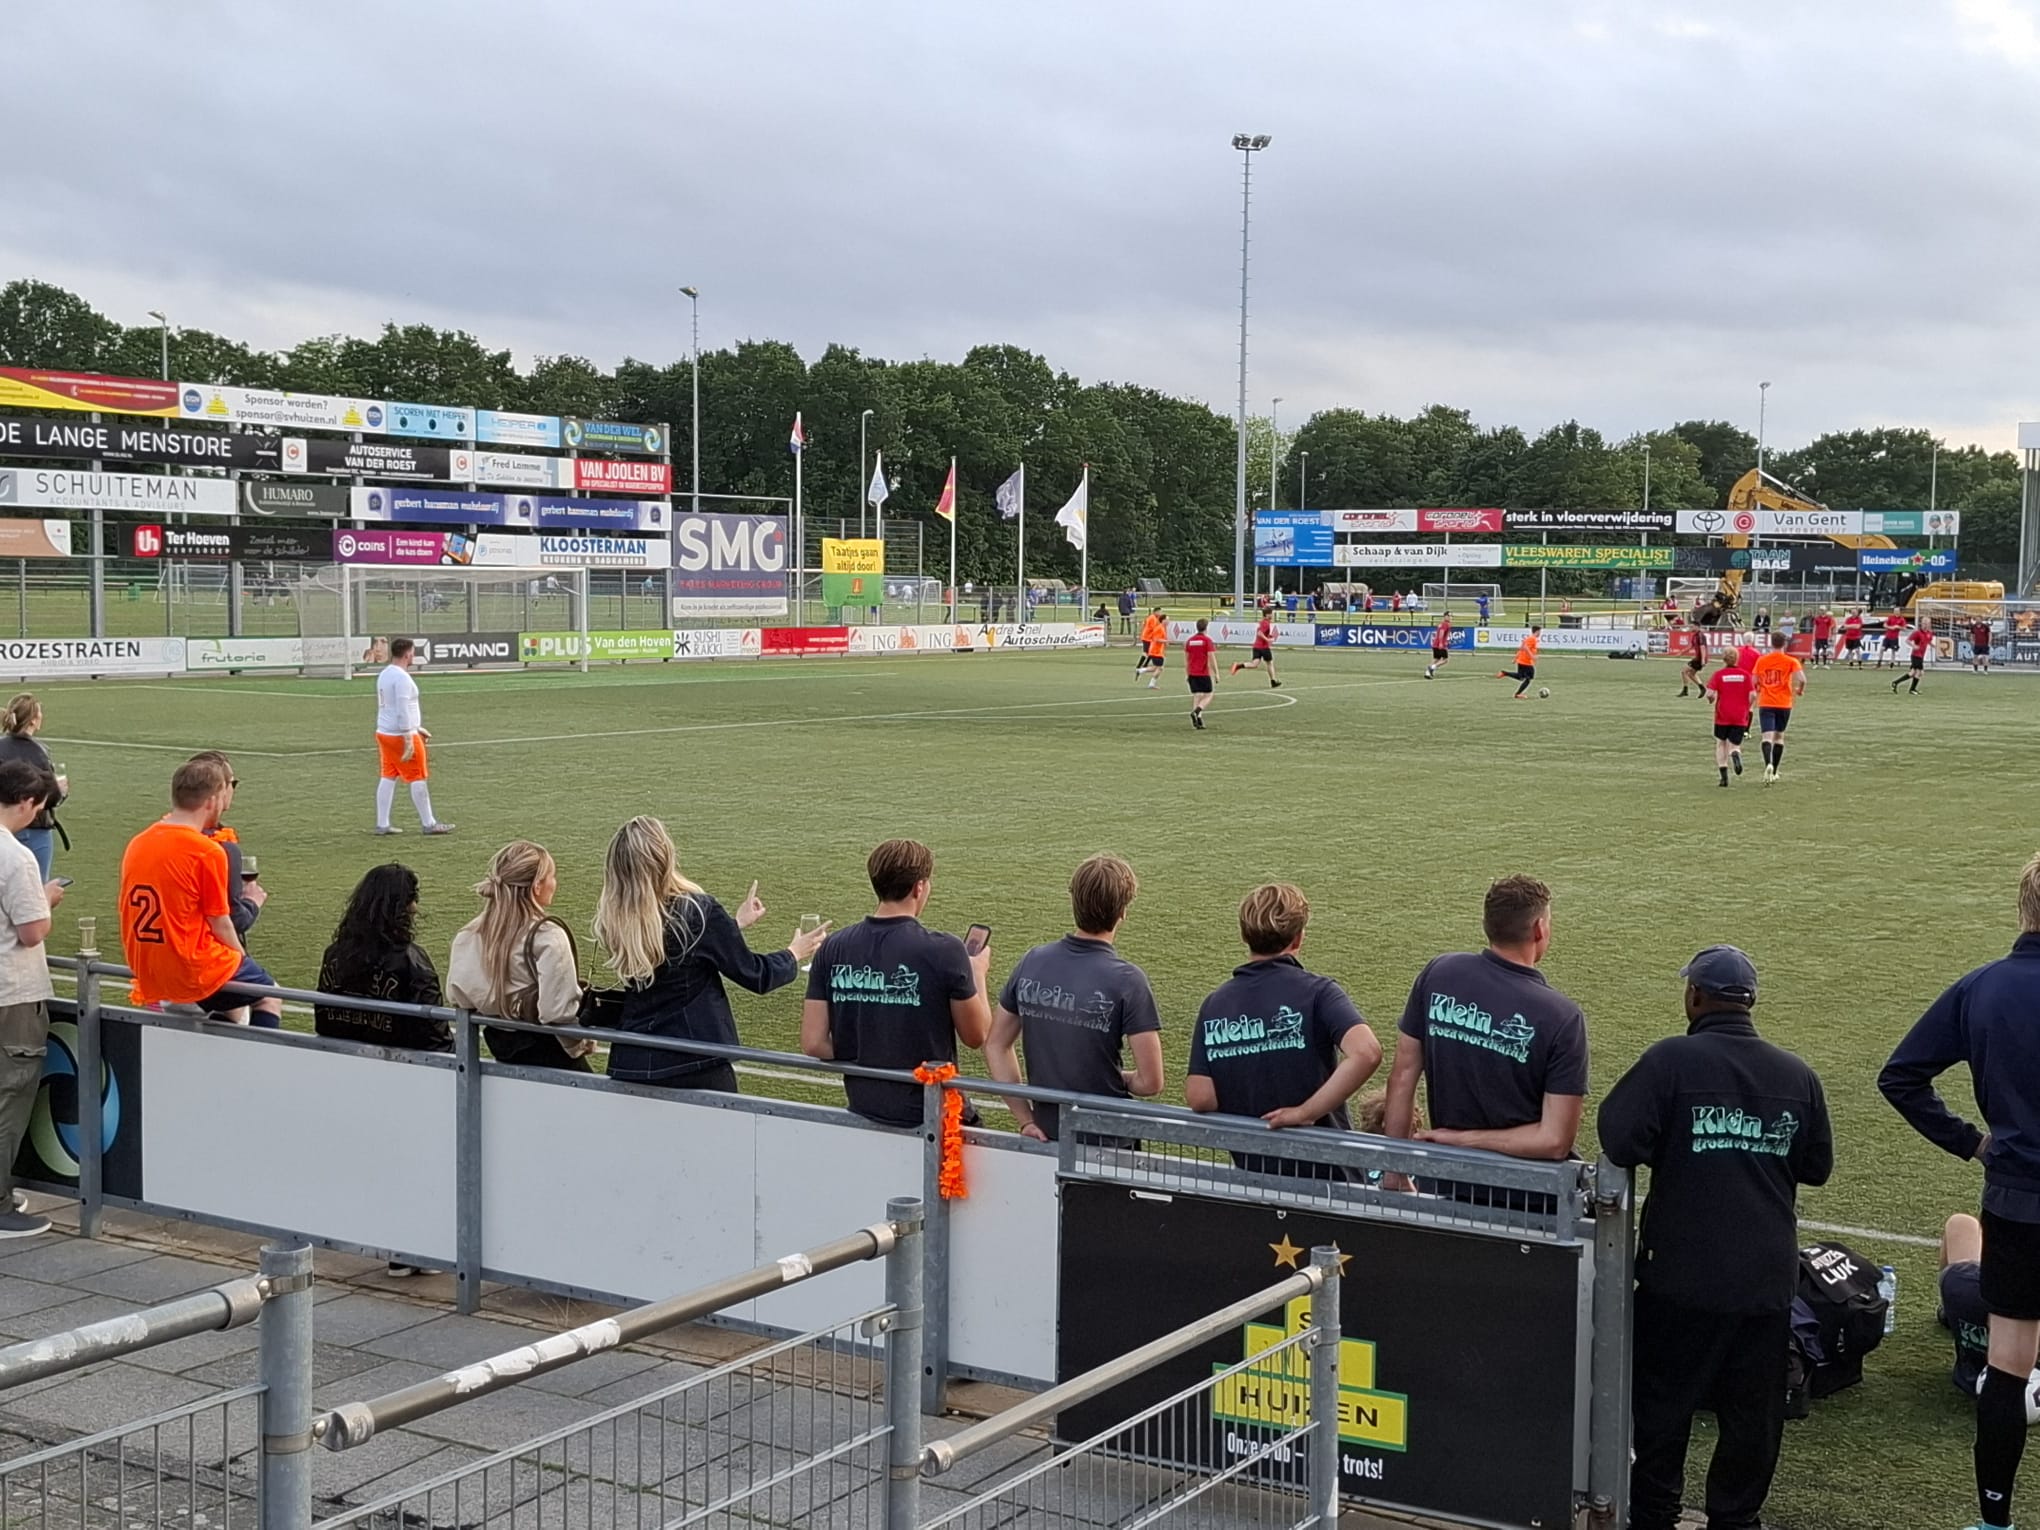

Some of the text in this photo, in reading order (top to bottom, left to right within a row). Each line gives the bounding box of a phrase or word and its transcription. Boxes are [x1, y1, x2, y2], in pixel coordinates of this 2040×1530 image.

[244, 394, 328, 410] Sponsor worden?
[236, 409, 337, 426] sponsor@svhuizen.nl
[394, 407, 424, 417] SCOREN
[36, 424, 109, 449] LANGE
[121, 430, 232, 458] MENSTORE
[349, 445, 412, 458] AUTOSERVICE
[345, 456, 416, 471] VAN DER ROEST
[492, 458, 510, 469] Fred
[580, 461, 665, 482] VAN JOOLEN BV
[36, 472, 197, 500] SCHUITEMAN
[263, 488, 314, 501] HUMARO
[1292, 517, 1320, 525] ROEST
[1506, 510, 1673, 526] sterk in vloerverwijdering
[1774, 513, 1847, 525] Van Gent
[166, 530, 230, 546] Ter Hoeven
[408, 538, 423, 547] kind
[423, 539, 435, 547] kan
[540, 537, 647, 554] KLOOSTERMAN
[679, 517, 784, 572] SMG
[358, 540, 385, 552] coins
[1353, 547, 1447, 557] Schaap & van Dijk
[1506, 547, 1591, 557] VLEESWAREN
[1595, 548, 1672, 559] SPECIALIST
[861, 549, 878, 559] gaan
[1862, 555, 1909, 565] Heineken
[836, 560, 876, 574] altijd door!
[1751, 560, 1790, 570] BAAS
[1017, 623, 1043, 635] Snel
[694, 631, 721, 643] SUSHI
[872, 634, 896, 649] ING
[929, 633, 950, 648] ING
[1002, 633, 1076, 646] Autoschade
[1496, 633, 1519, 642] VEEL
[1563, 634, 1579, 643] S.V.
[1581, 634, 1623, 644] HUIZEN!
[0, 641, 140, 660] ROZESTRATEN
[434, 642, 509, 658] STANNO
[540, 635, 671, 656] PLUS Van den Hoven
[694, 643, 722, 655] RAKKI
[129, 884, 165, 944] 2
[831, 964, 885, 990] Klein
[1017, 977, 1075, 1011] Klein
[1429, 992, 1492, 1035] Klein
[1204, 1014, 1265, 1045] Klein
[1239, 1385, 1379, 1428] HUIEN
[1227, 1432, 1258, 1456] Onze
[1343, 1453, 1384, 1480] trots!
